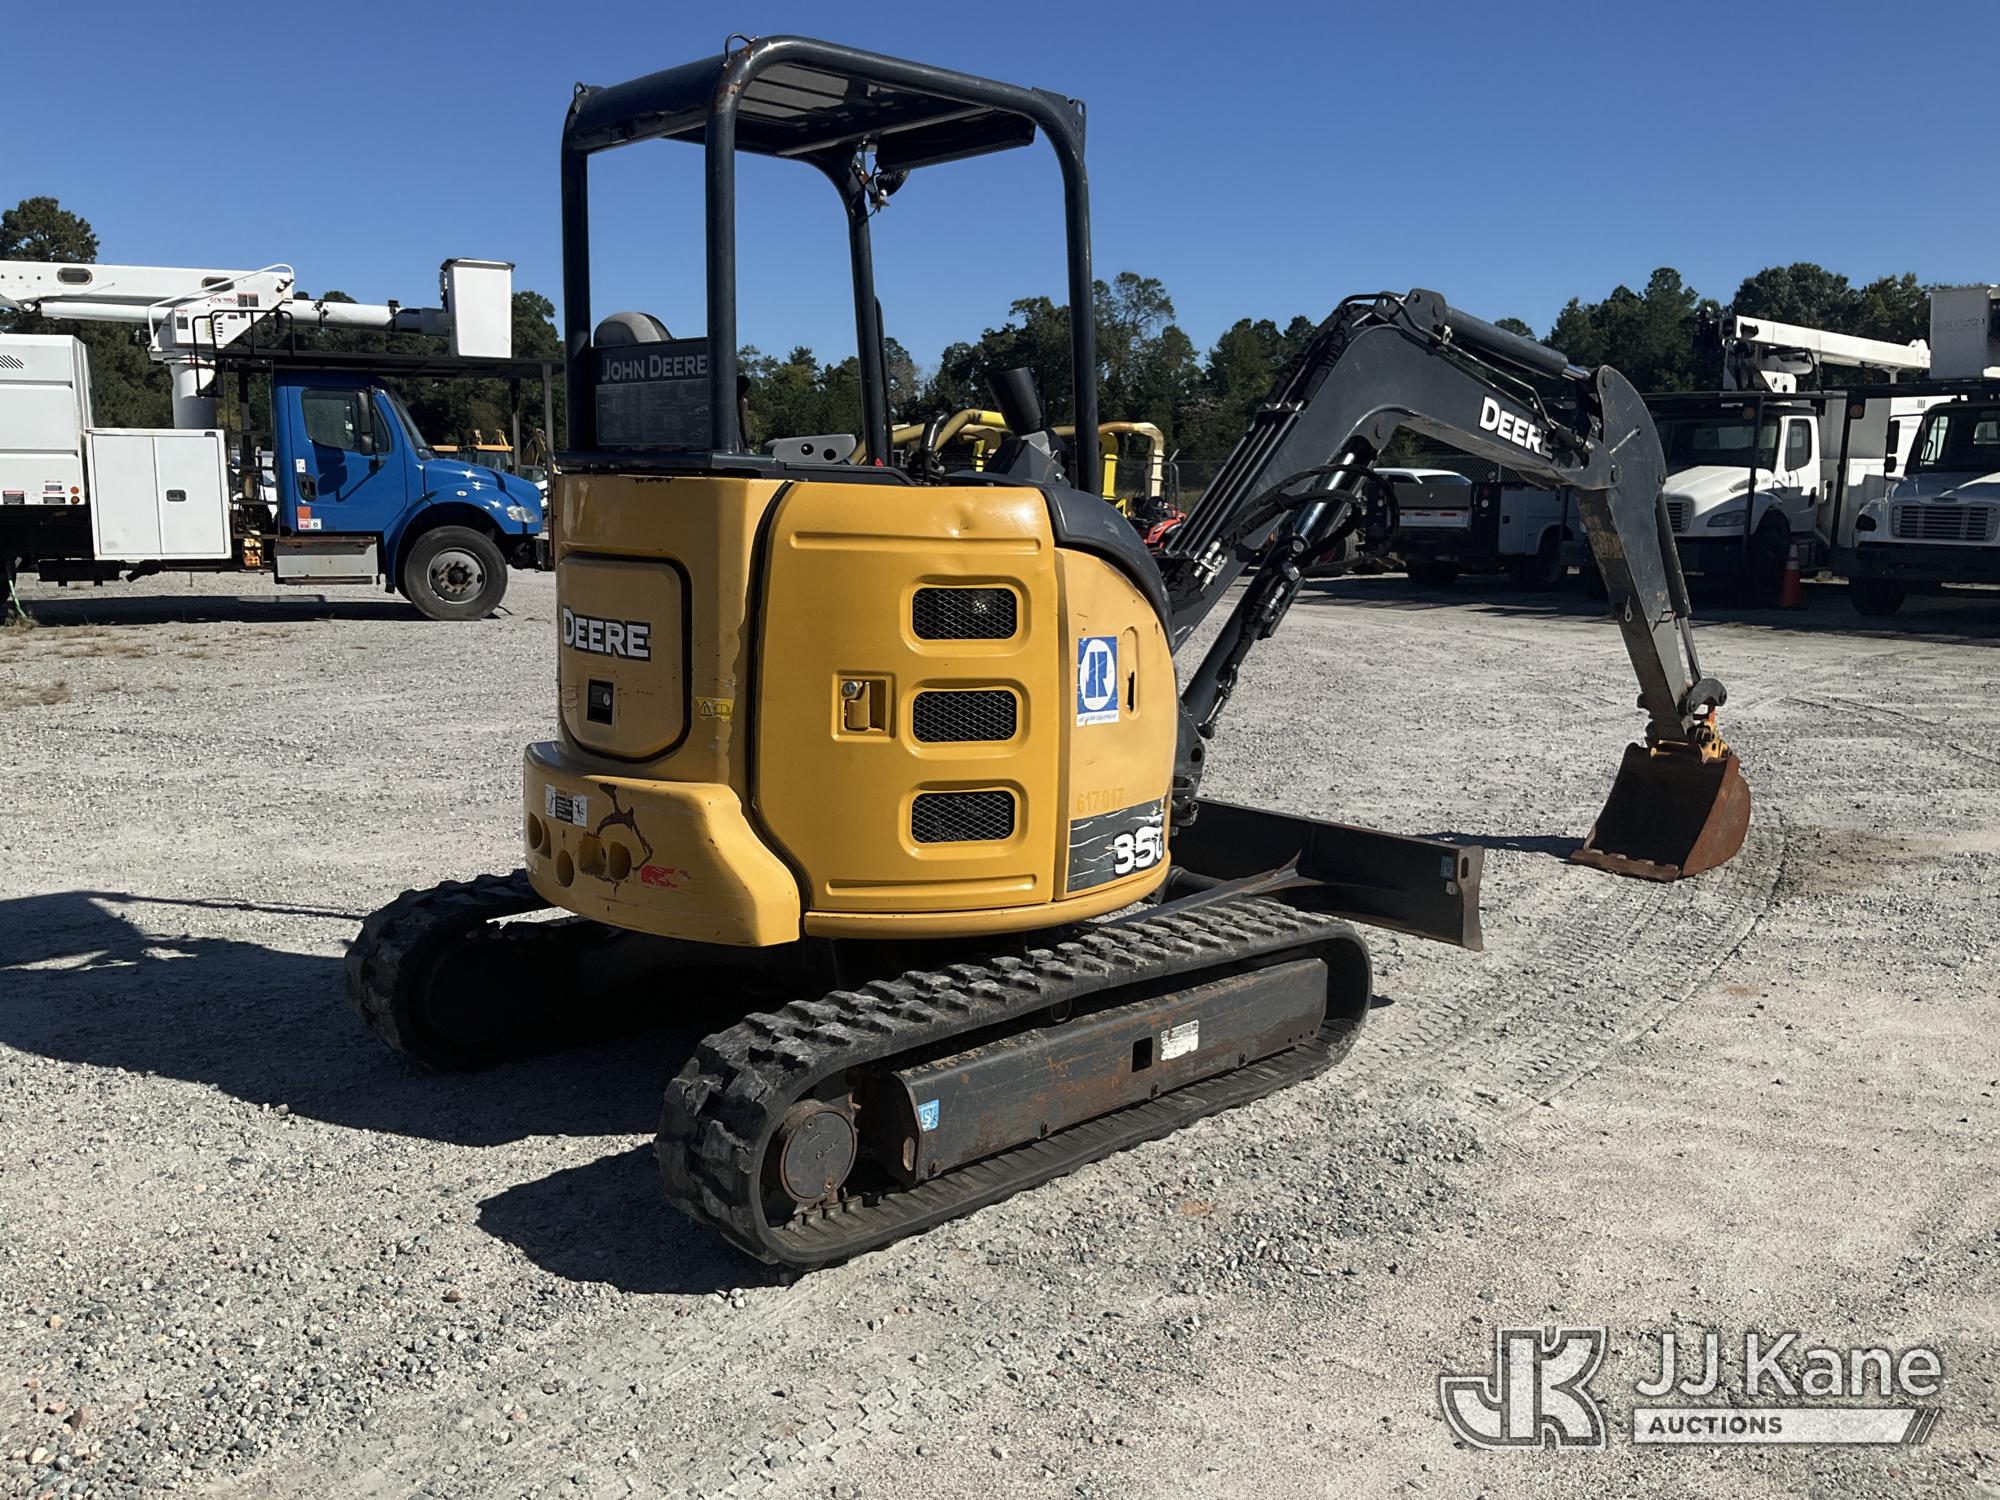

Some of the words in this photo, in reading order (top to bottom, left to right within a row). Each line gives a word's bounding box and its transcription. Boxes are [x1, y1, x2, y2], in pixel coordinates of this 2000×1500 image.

[602, 358, 645, 381] JOHN
[650, 354, 708, 378] DEERE
[563, 608, 649, 658] DEERE
